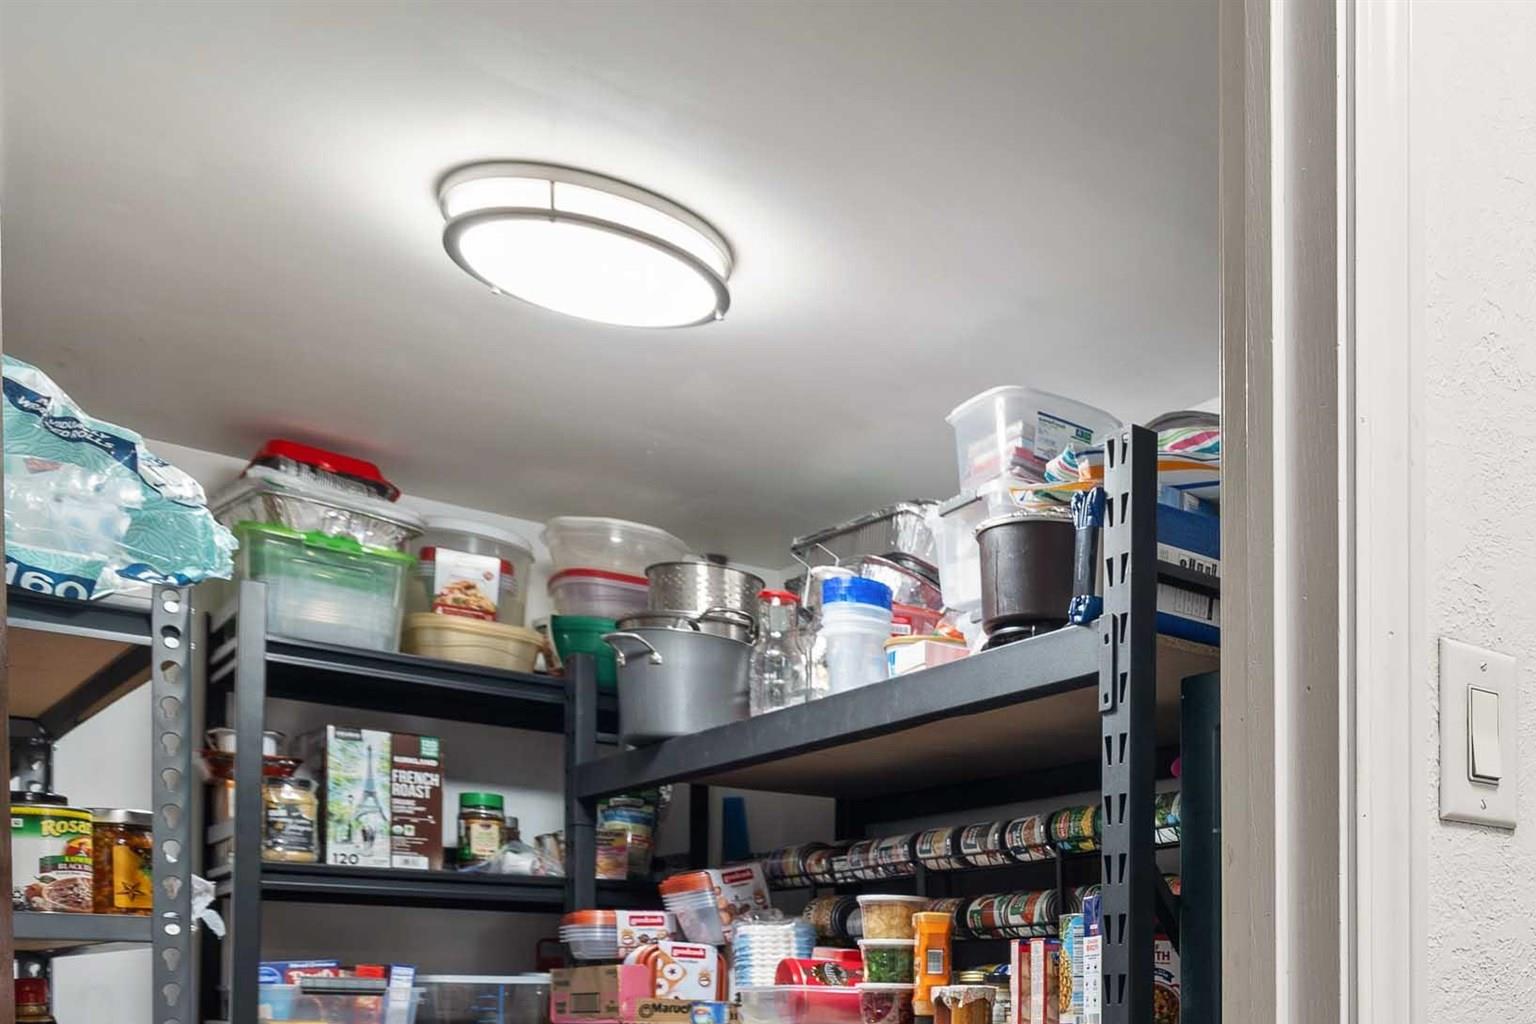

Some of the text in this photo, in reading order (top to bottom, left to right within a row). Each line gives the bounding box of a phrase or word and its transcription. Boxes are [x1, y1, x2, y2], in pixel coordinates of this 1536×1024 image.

[392, 769, 440, 787] FRENCH
[392, 783, 432, 799] ROAST
[332, 853, 359, 865] 120
